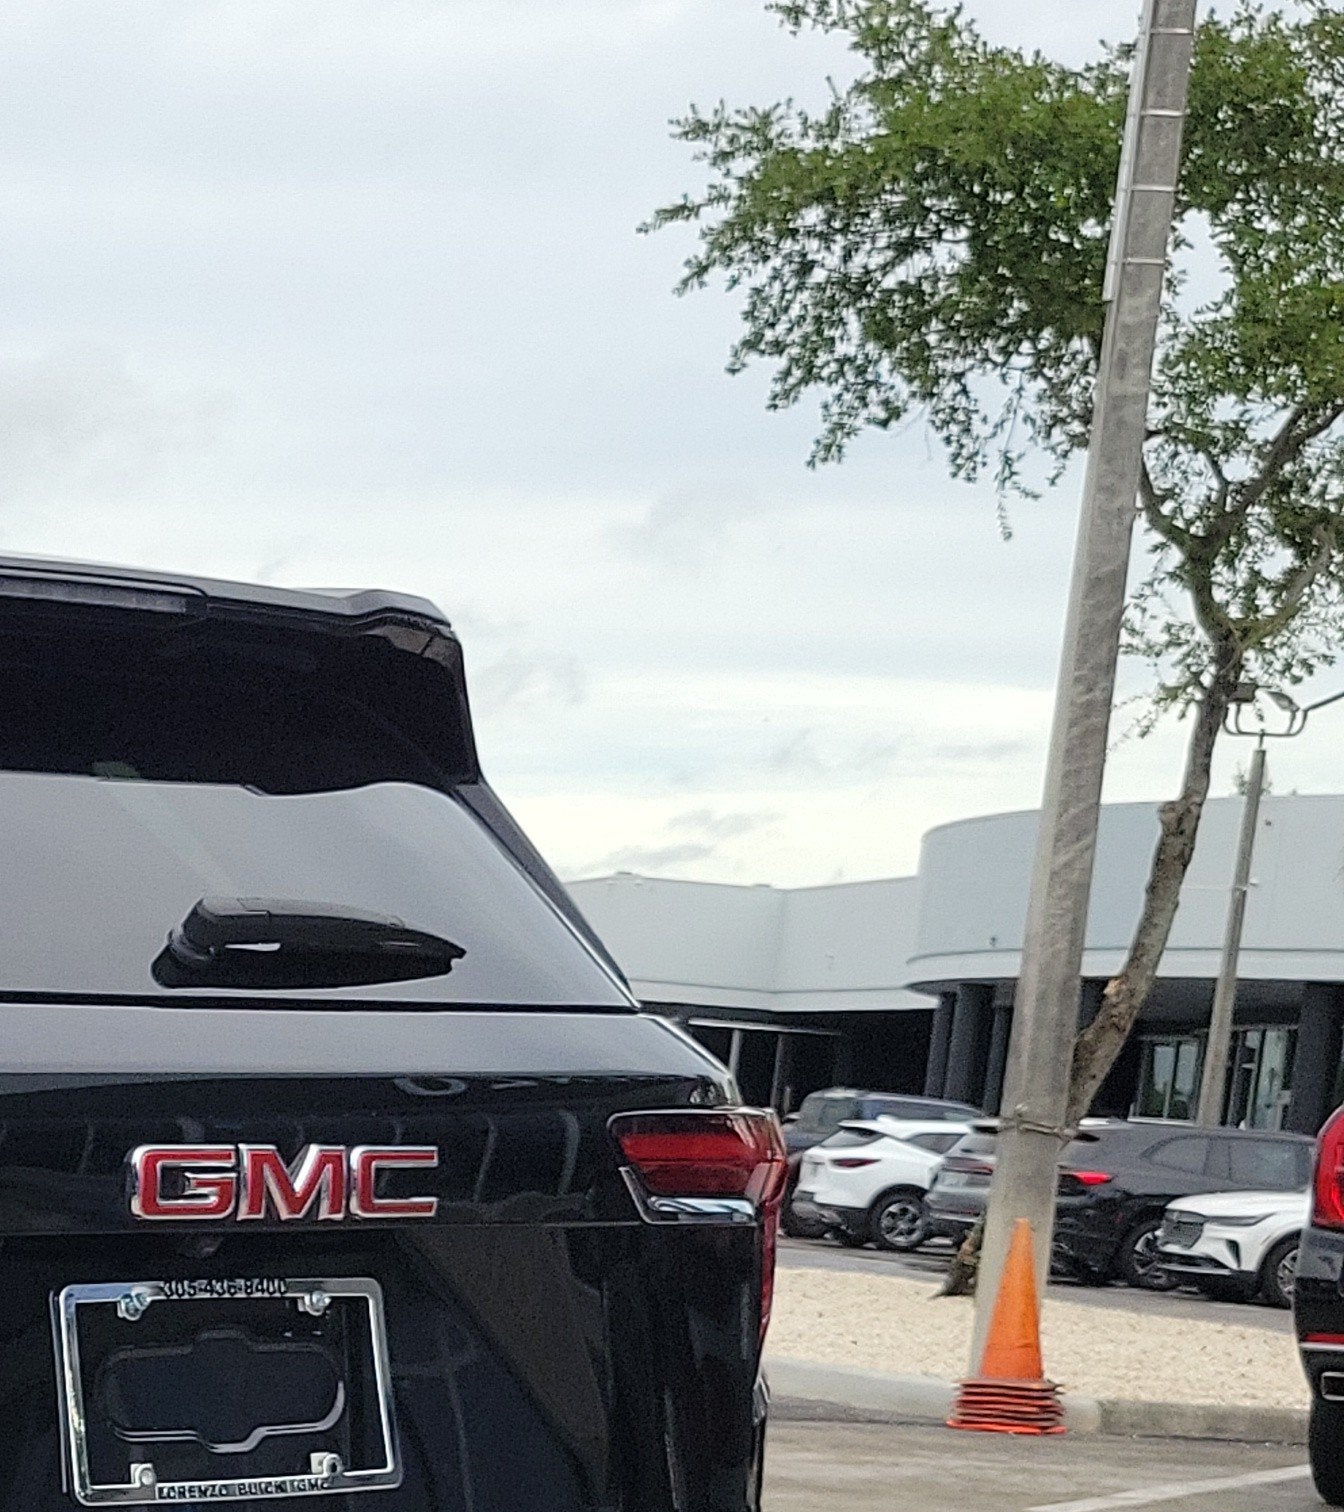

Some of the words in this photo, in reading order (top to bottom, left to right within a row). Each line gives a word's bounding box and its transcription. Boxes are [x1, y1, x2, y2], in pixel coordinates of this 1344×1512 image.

[129, 1143, 438, 1221] GMC
[157, 1483, 228, 1500] LORENZO
[237, 1480, 287, 1497] BUICK
